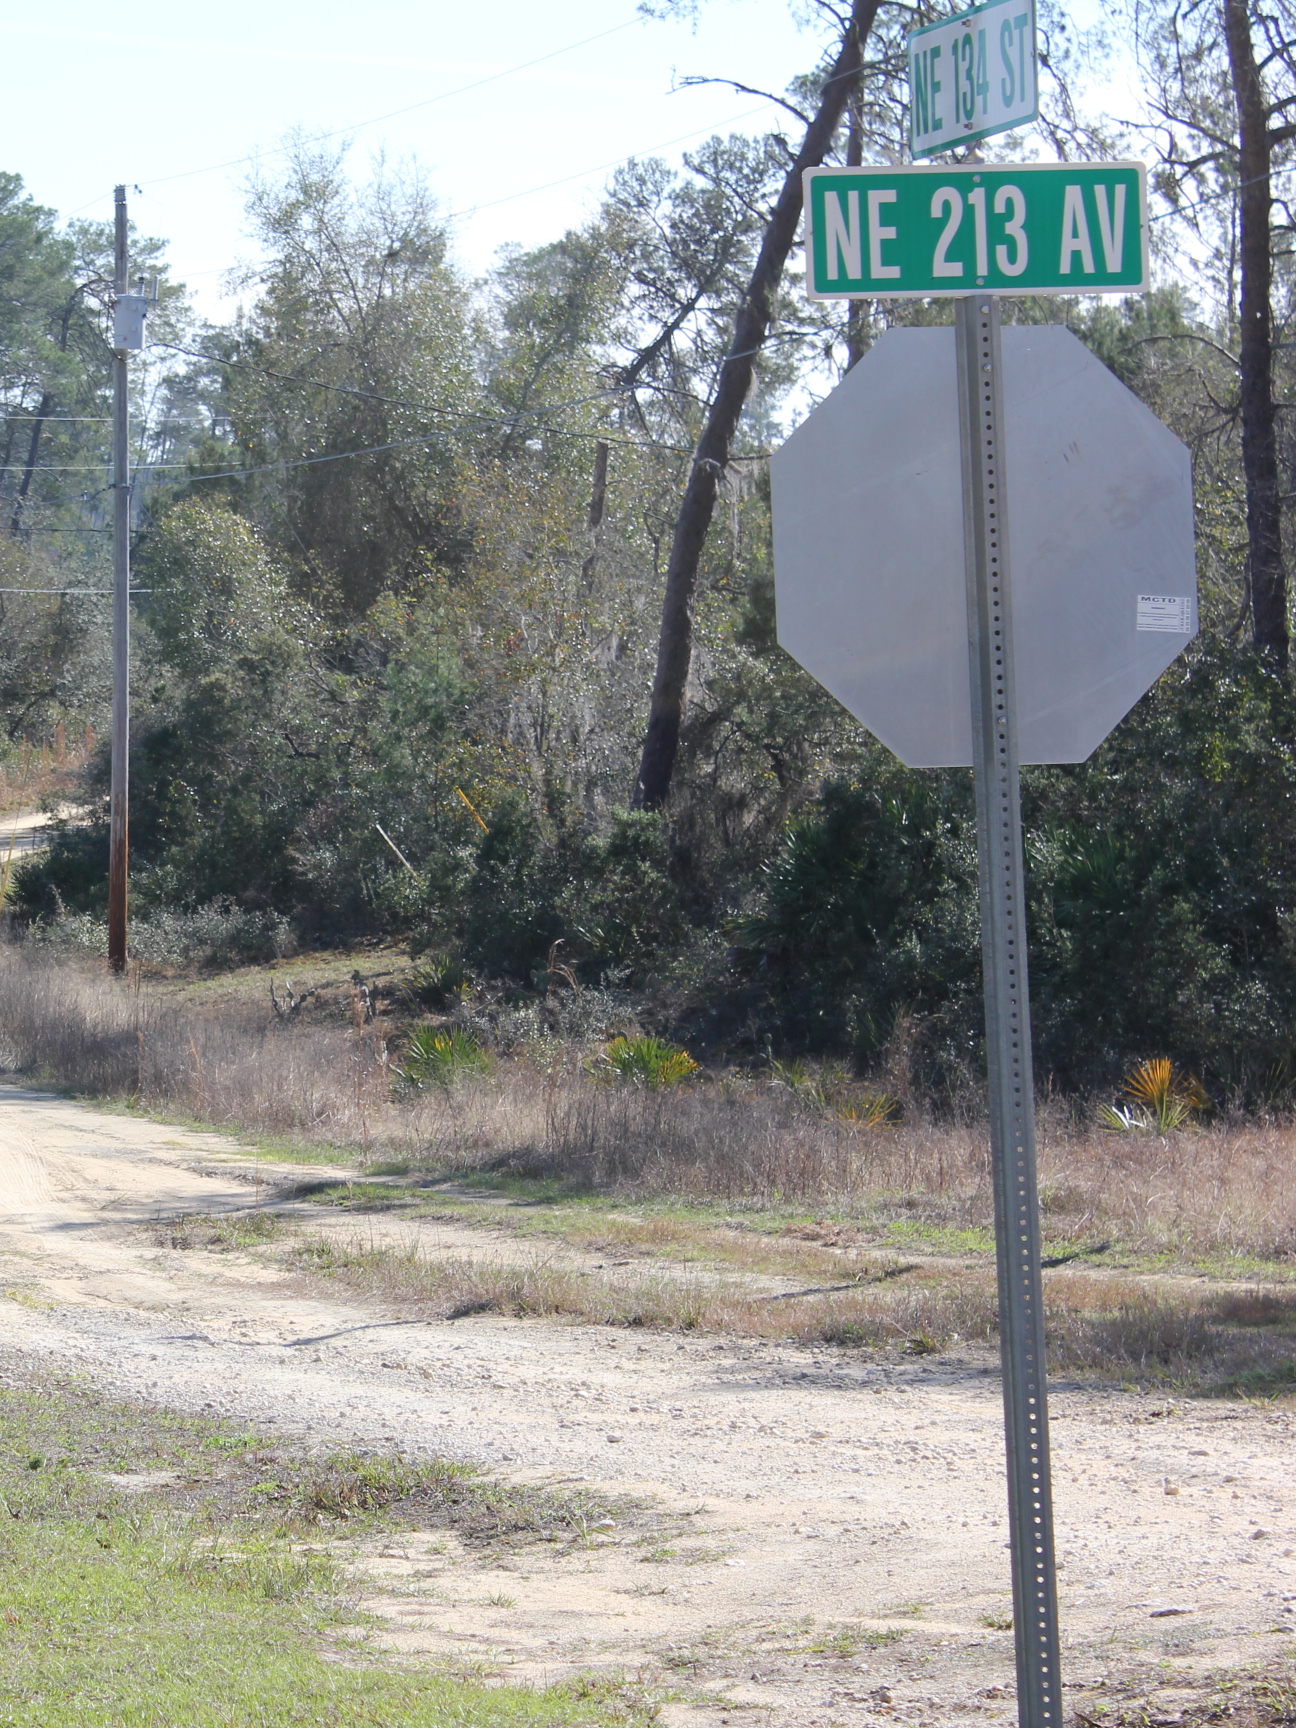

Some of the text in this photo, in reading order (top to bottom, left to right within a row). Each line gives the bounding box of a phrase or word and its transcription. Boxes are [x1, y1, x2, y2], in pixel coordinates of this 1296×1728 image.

[914, 12, 1029, 138] NE 134 ST
[824, 183, 1127, 281] NE 213 AV
